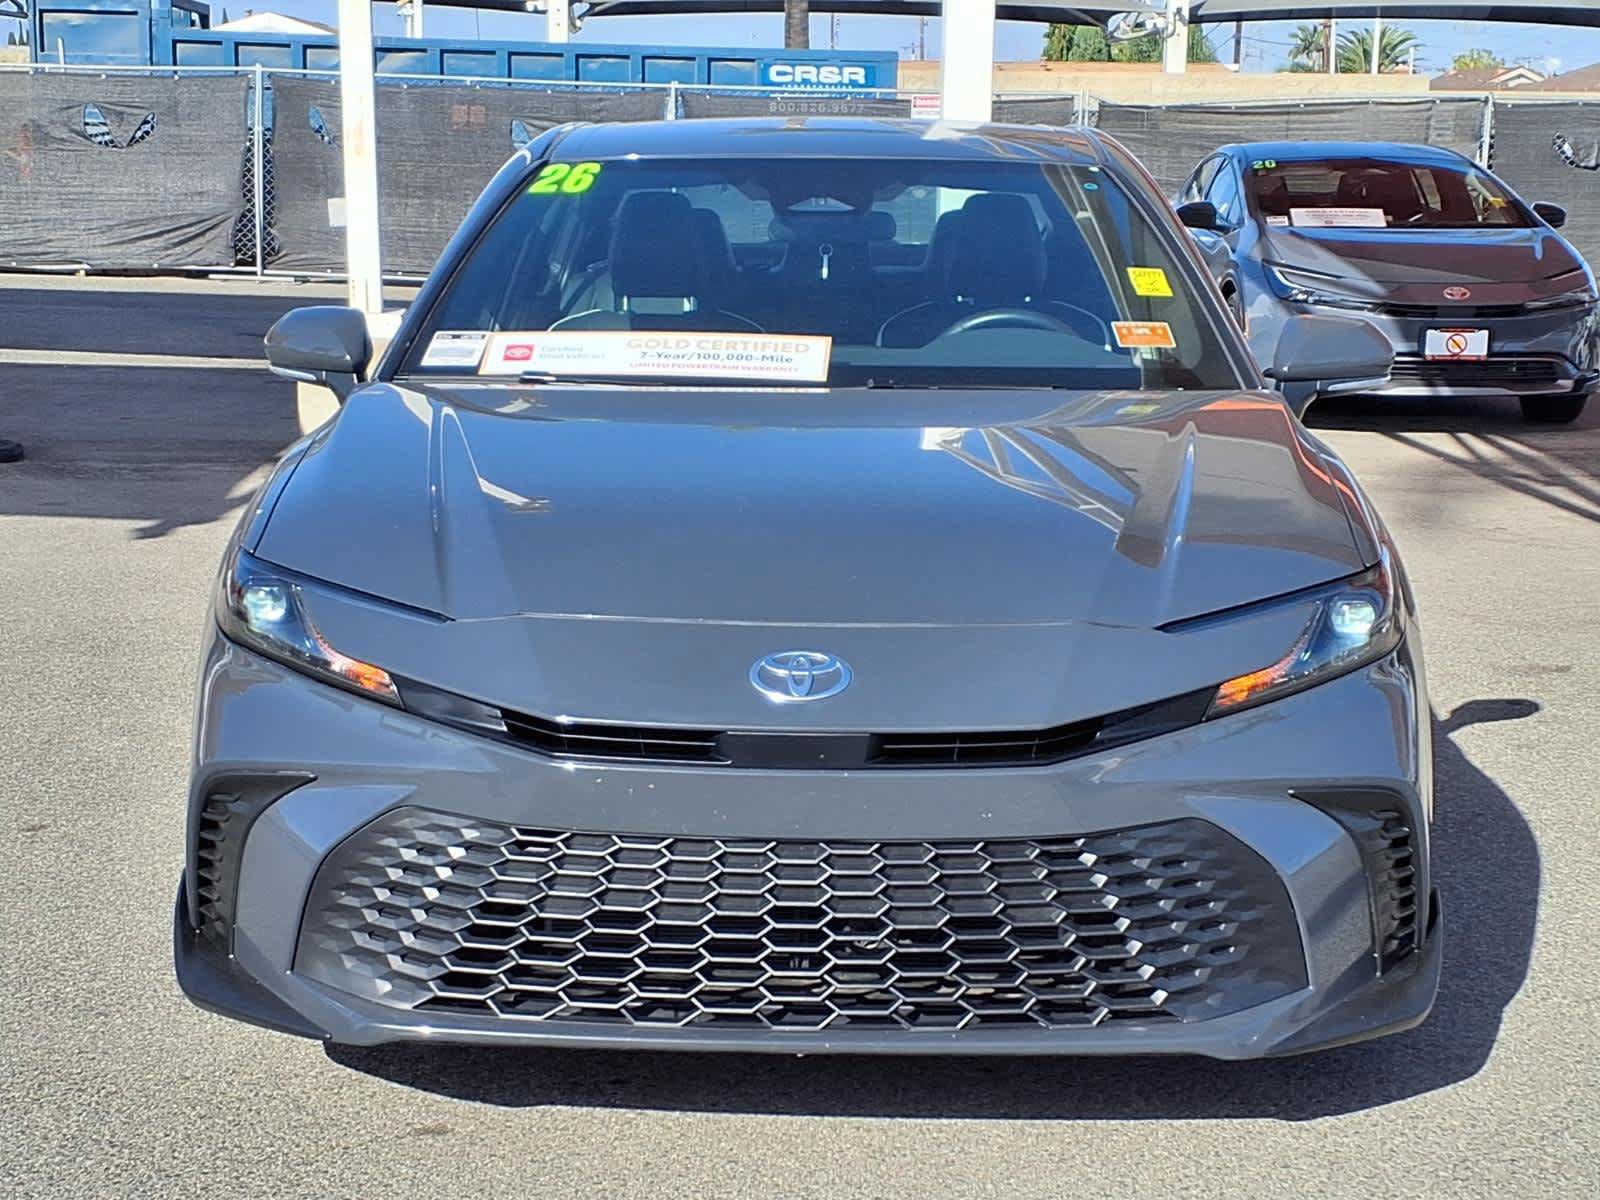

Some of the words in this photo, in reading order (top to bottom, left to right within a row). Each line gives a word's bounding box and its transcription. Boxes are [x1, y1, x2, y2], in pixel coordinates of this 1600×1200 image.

[1252, 160, 1276, 169] 20
[527, 163, 601, 193] 26
[626, 338, 690, 350] GOLD
[696, 339, 811, 353] CERTIFIED
[640, 351, 793, 364] 7-Year/100,000-Mile
